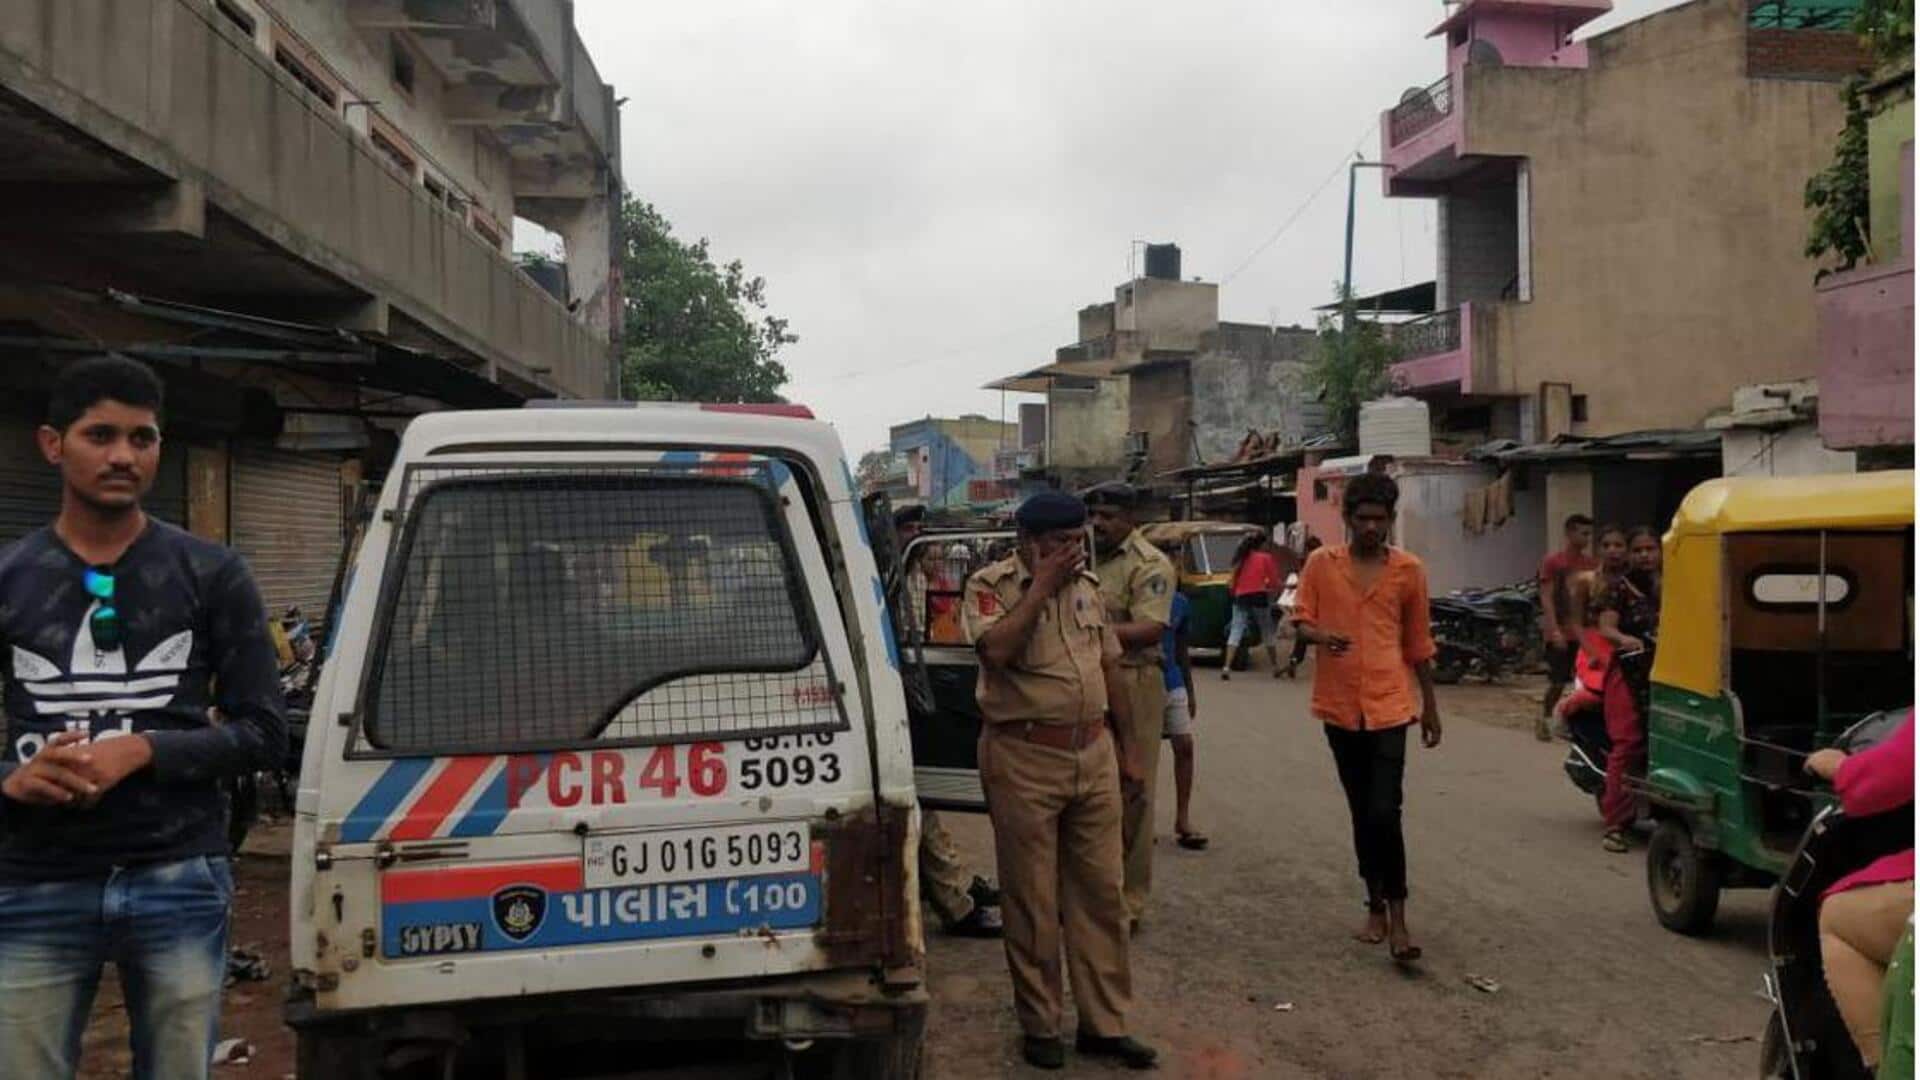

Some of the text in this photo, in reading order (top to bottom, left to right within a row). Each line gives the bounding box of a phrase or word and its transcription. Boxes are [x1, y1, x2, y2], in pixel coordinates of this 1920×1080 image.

[505, 739, 728, 808] PCR 46
[740, 753, 841, 789] 5093
[612, 830, 802, 877] GJ 01G 5093
[402, 924, 481, 953] GYPSY
